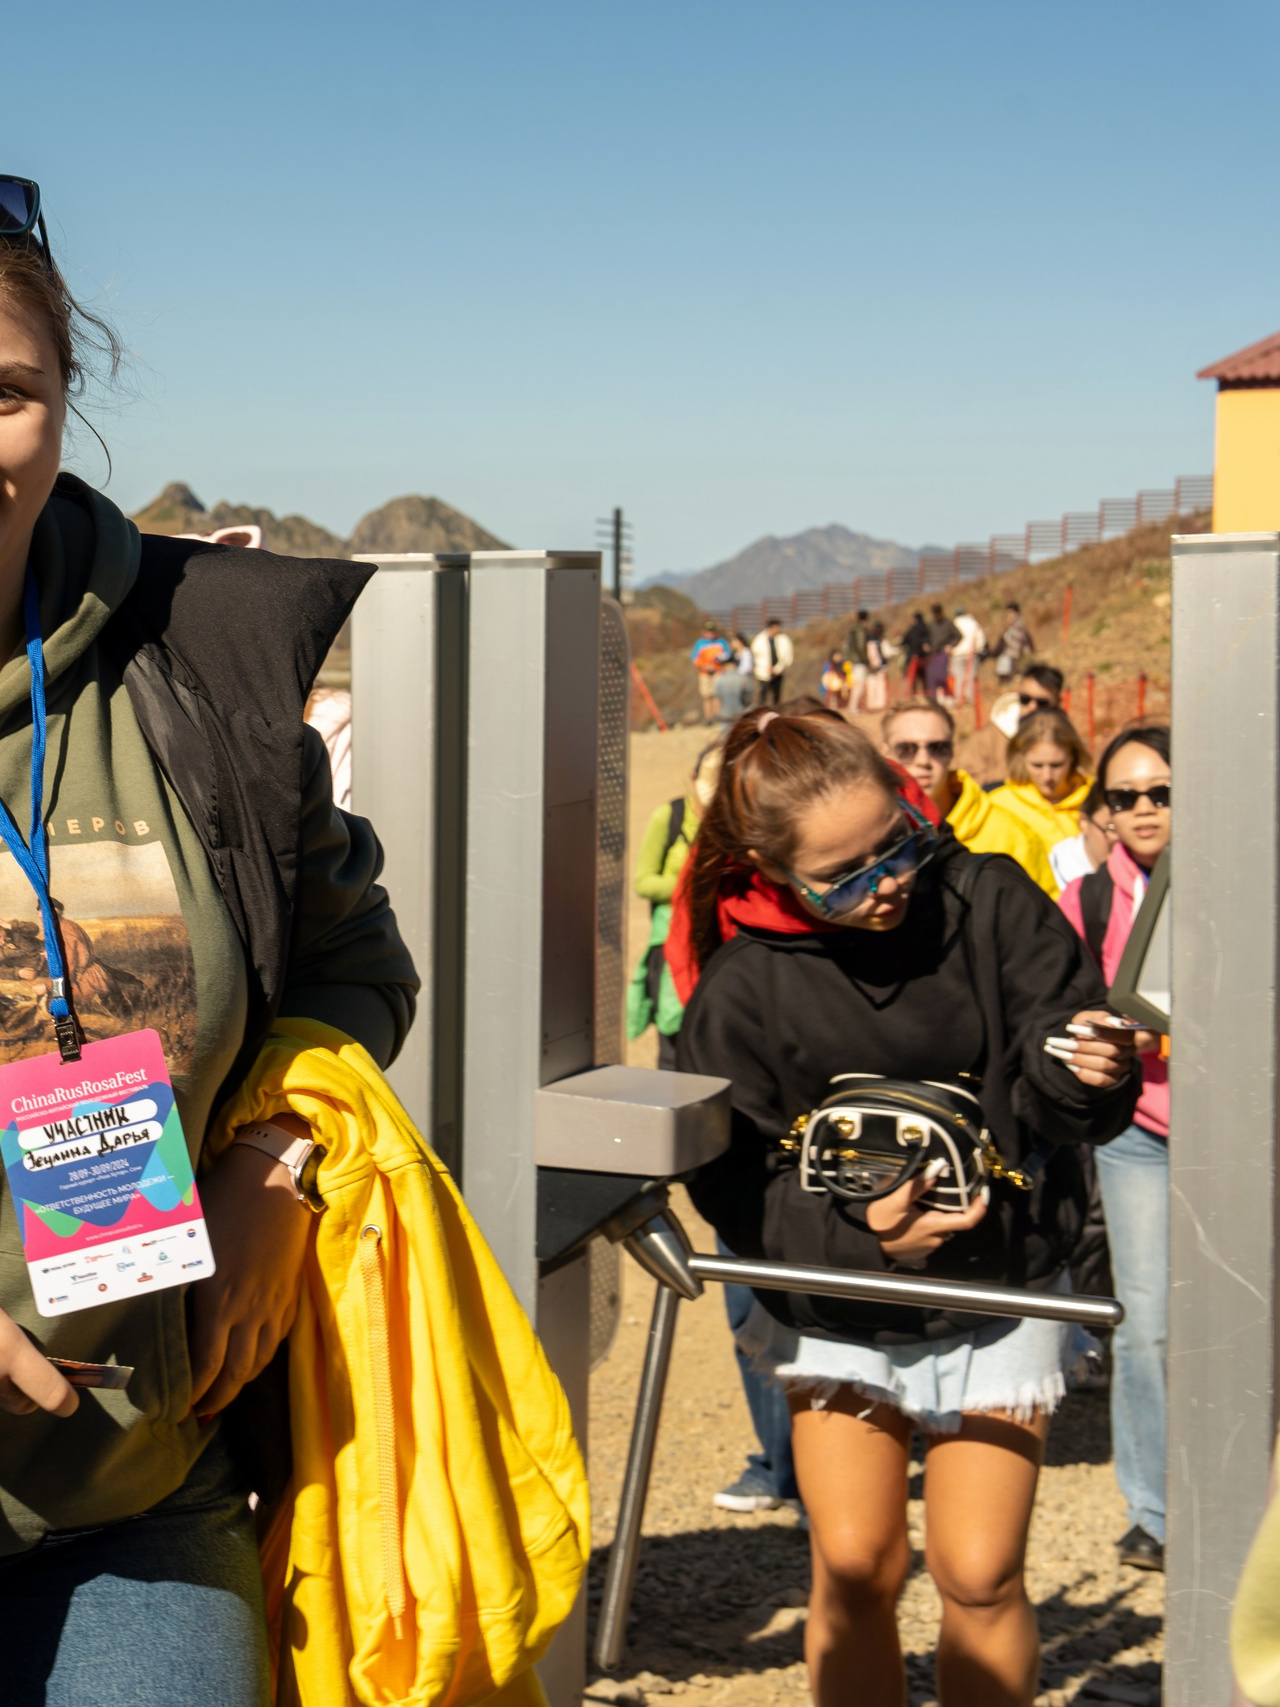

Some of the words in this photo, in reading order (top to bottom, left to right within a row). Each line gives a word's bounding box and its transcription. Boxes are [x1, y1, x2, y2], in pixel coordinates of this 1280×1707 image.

[11, 1067, 148, 1114] ChinaRusRosaFest
[43, 1107, 130, 1144] УЧАСТНИК
[72, 1198, 113, 1215] БУДУЩЕЕ
